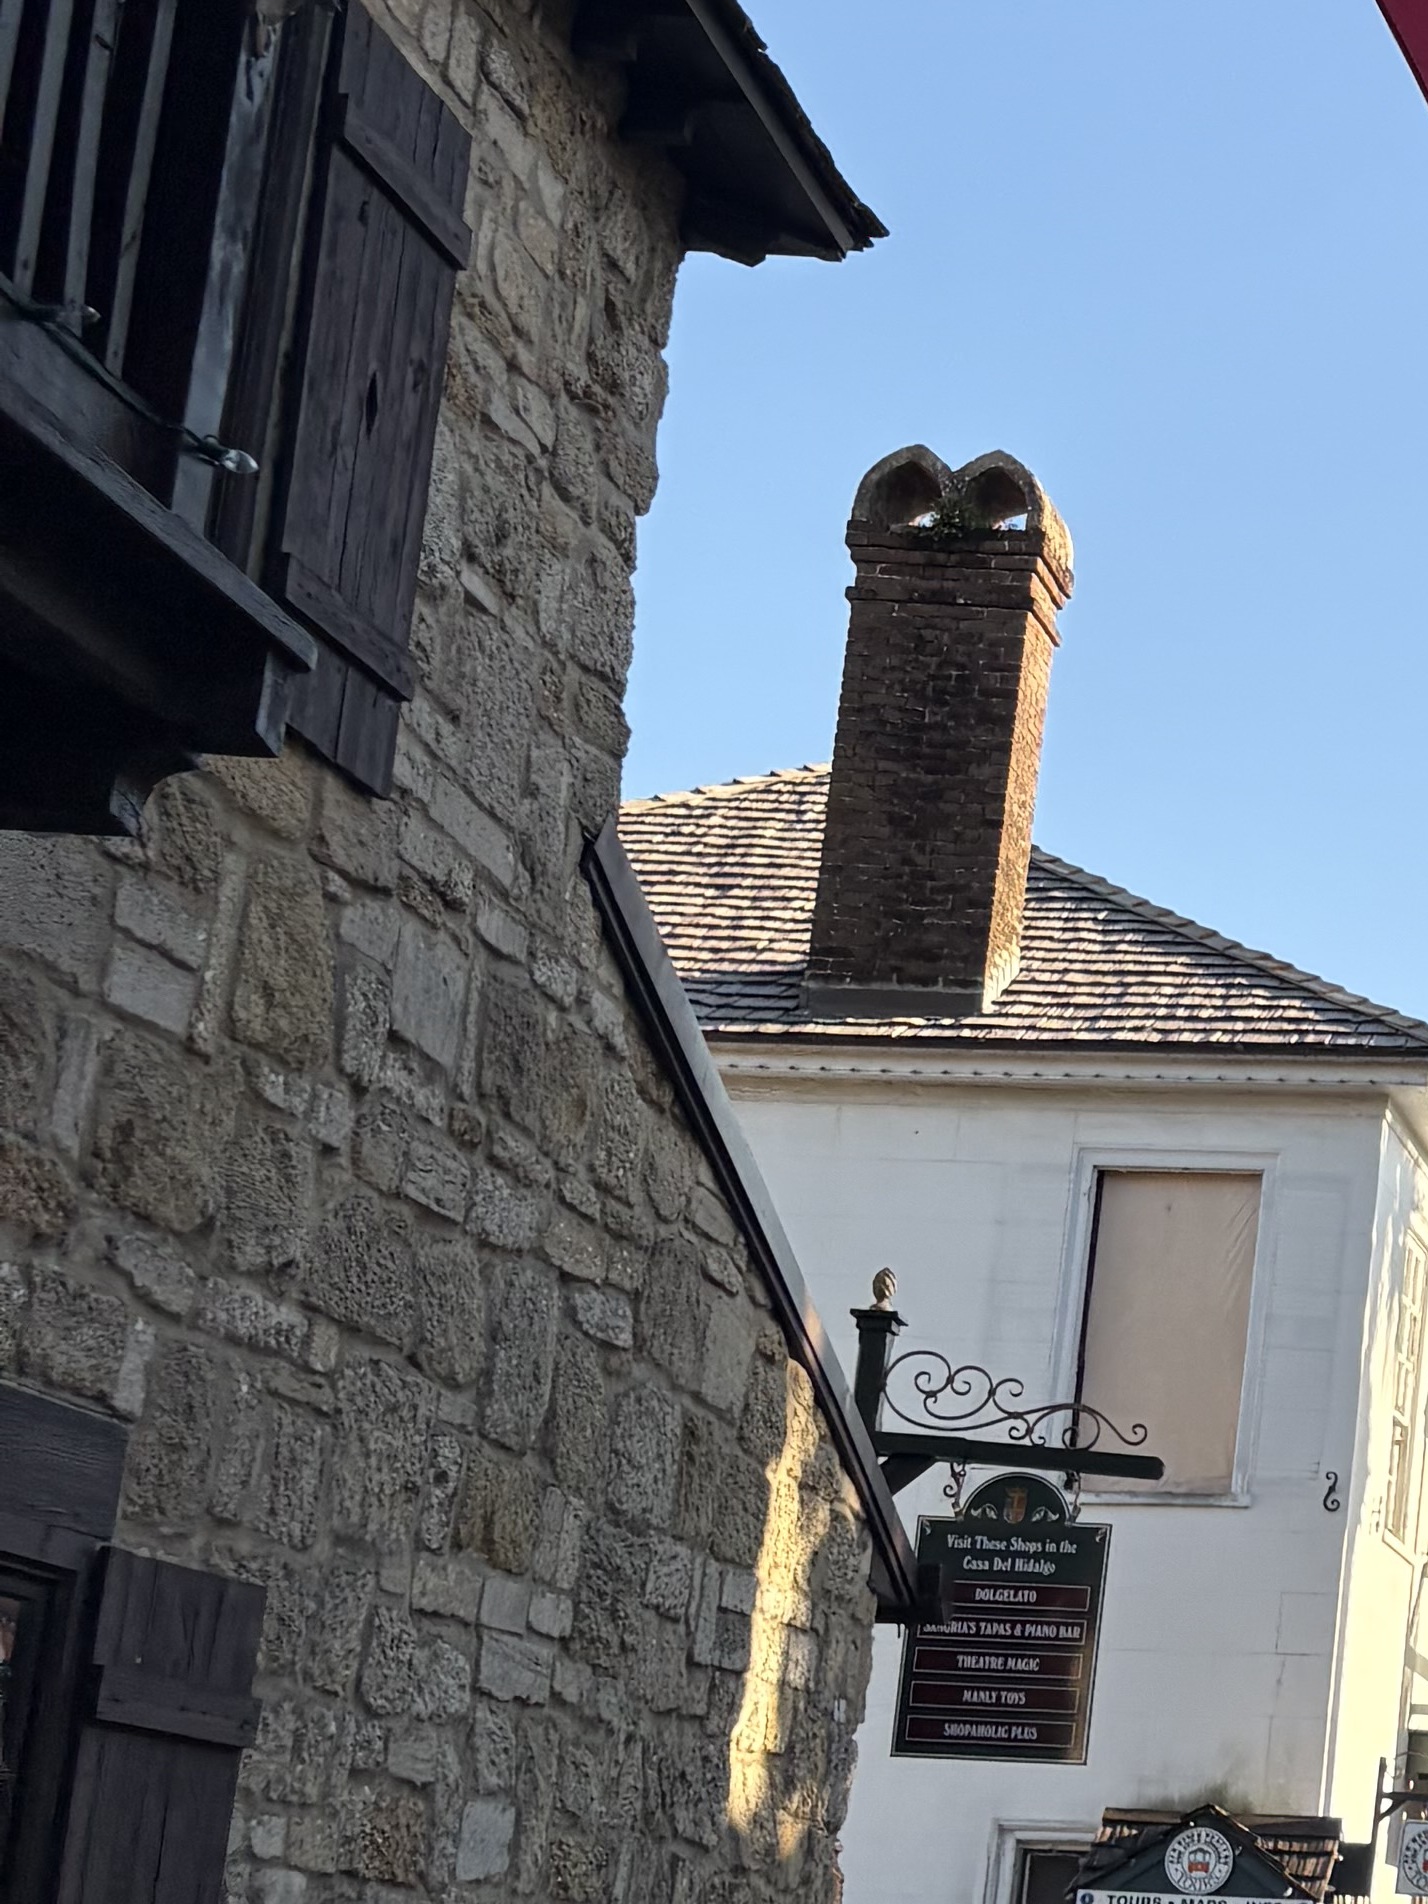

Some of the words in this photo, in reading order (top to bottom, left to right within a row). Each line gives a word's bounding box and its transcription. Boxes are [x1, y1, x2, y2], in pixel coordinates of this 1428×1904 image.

[947, 1534, 972, 1549] Visit
[974, 1535, 1007, 1551] These
[1010, 1536, 1042, 1554] Shops
[1045, 1539, 1057, 1553] in
[1060, 1539, 1077, 1554] the
[962, 1555, 989, 1571] Casa
[993, 1557, 1011, 1571] Del
[1014, 1558, 1056, 1576] Hidalgo
[979, 1621, 1012, 1636] TAPAS
[1013, 1624, 1023, 1636] &
[1024, 1624, 1056, 1638] PIANO
[1059, 1625, 1081, 1639] BAR
[957, 1654, 1004, 1670] THEATRE
[1006, 1656, 1040, 1672] MAGIC
[962, 1689, 998, 1704] MANLY
[1000, 1691, 1026, 1705] TOYS
[1011, 1726, 1038, 1740] PLUS
